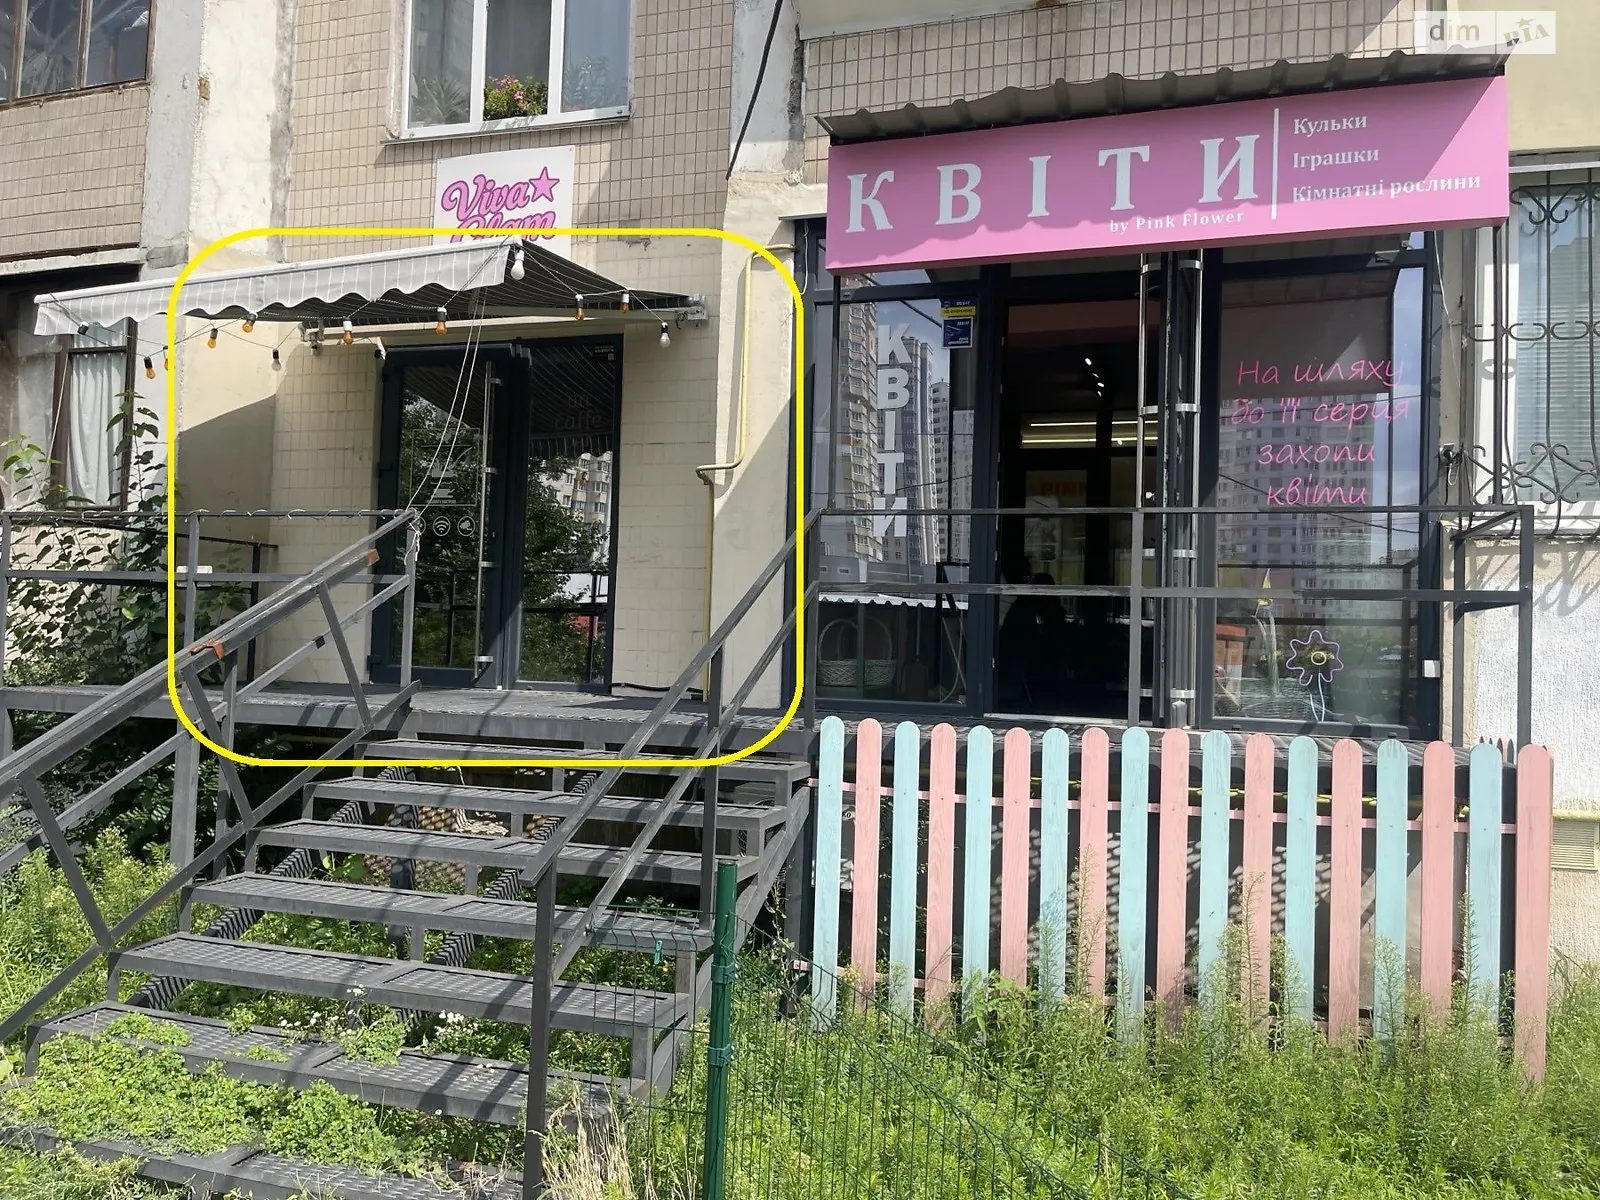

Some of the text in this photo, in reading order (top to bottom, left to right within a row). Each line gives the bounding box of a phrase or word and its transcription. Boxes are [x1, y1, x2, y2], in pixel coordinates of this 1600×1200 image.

[1293, 116, 1367, 137] Кульки
[1293, 149, 1379, 171] Іграшки
[441, 174, 530, 221] Viva
[845, 134, 1260, 233] КВІТИ
[1292, 176, 1480, 203] Кімнатні рослини
[1110, 212, 1244, 235] by Pink Flower
[1237, 359, 1404, 387] На шляху
[1231, 398, 1264, 424] до
[1313, 400, 1409, 429] серця
[873, 324, 912, 537] КВІТИ
[1258, 444, 1375, 464] захопи
[1266, 474, 1366, 505] квіти
